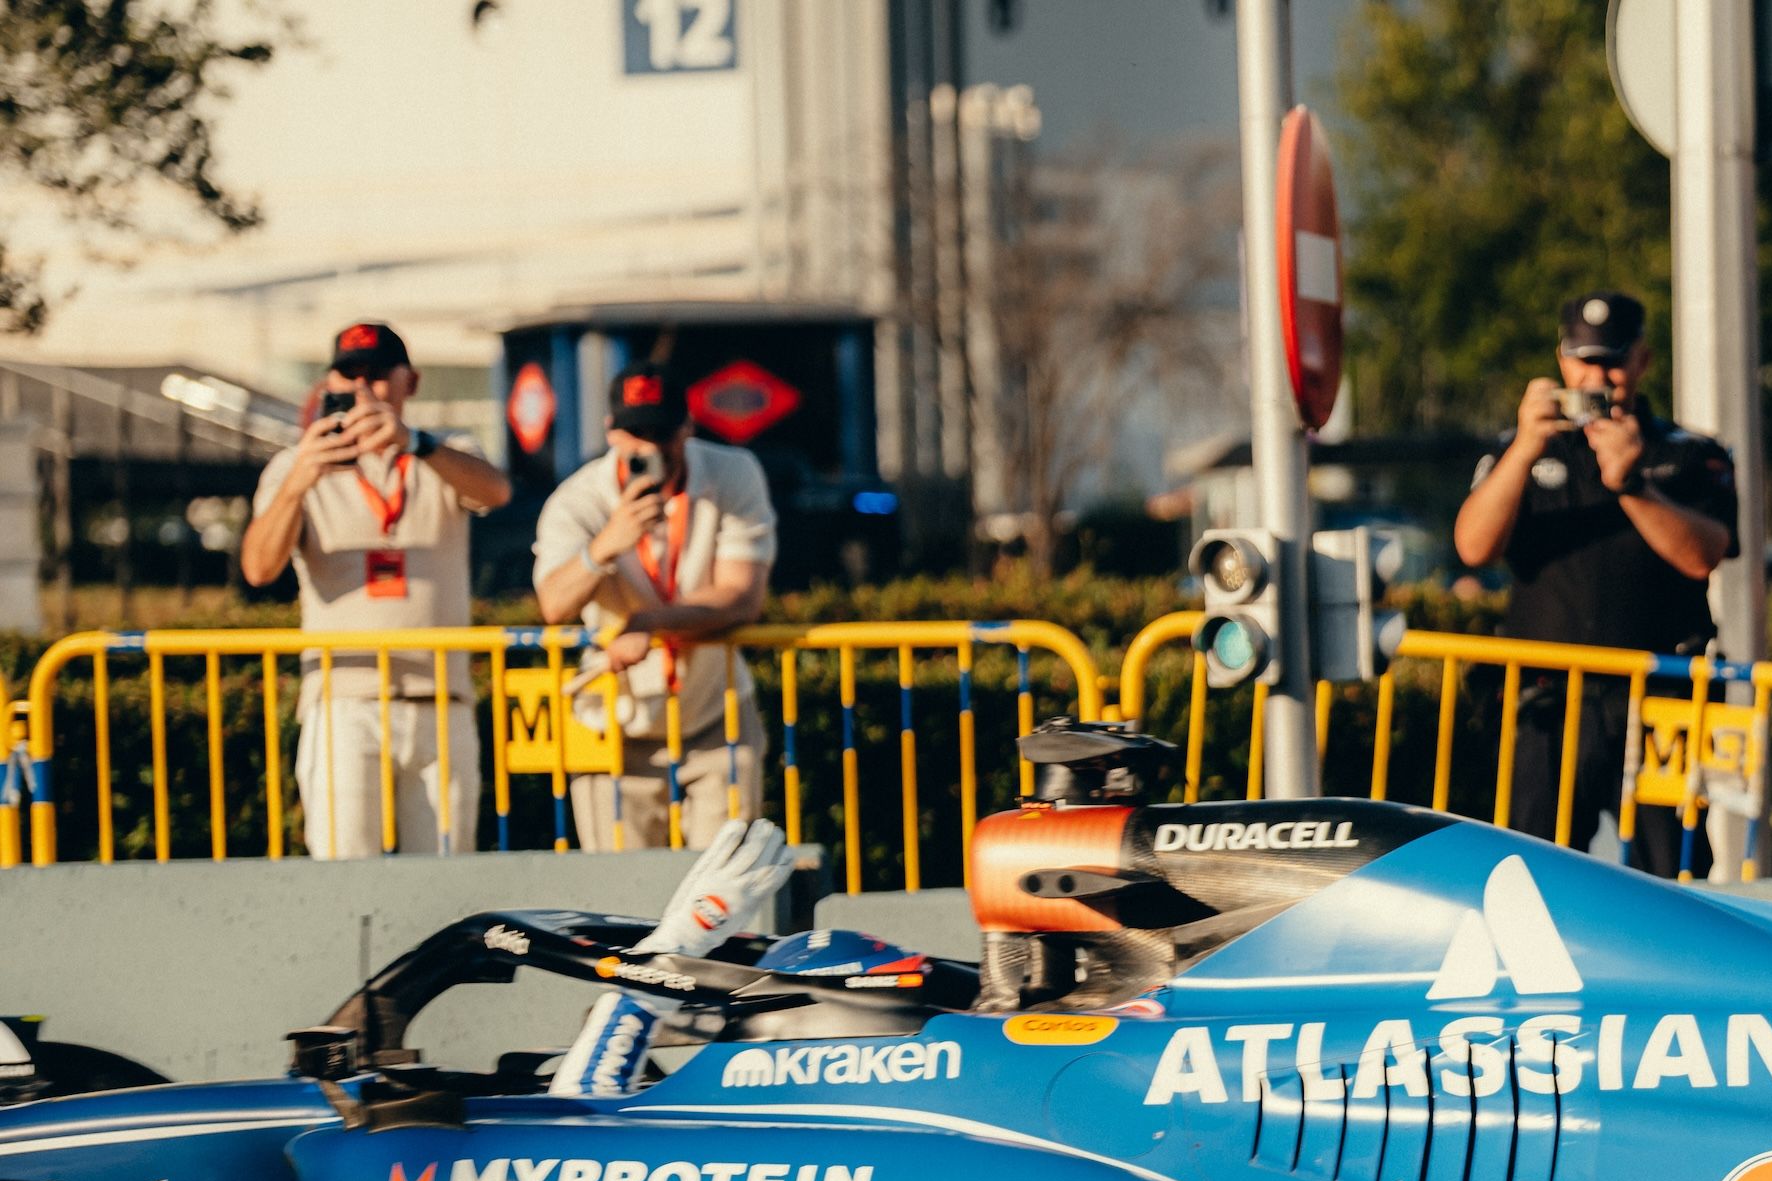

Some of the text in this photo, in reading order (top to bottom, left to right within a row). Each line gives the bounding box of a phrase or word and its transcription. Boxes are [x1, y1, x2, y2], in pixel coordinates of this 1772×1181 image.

[633, 0, 734, 69] 12
[1154, 821, 1360, 852] DURACELL
[1022, 1018, 1099, 1033] Carlos
